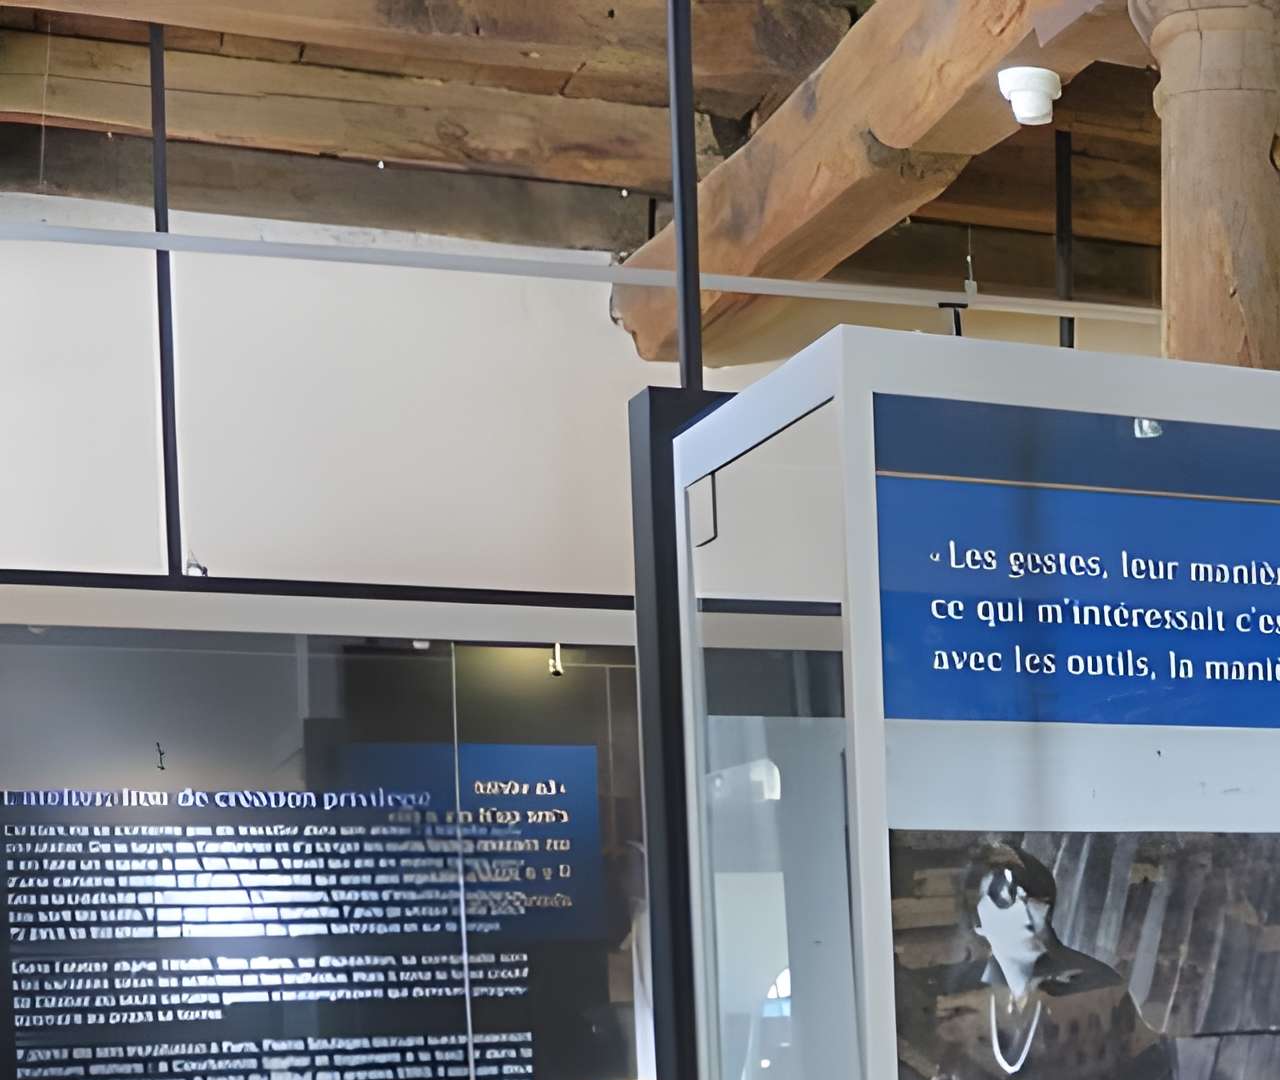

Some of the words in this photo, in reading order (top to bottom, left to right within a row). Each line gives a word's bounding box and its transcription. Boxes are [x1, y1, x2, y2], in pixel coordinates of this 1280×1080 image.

[949, 541, 997, 570] Les
[1008, 551, 1108, 579] gestes,
[1121, 550, 1179, 581] leur
[931, 599, 964, 620] ce
[976, 598, 1024, 628] qui
[933, 650, 1002, 672] avec
[1015, 645, 1056, 674] les
[1067, 649, 1156, 681] outils,
[1169, 650, 1194, 679] la
